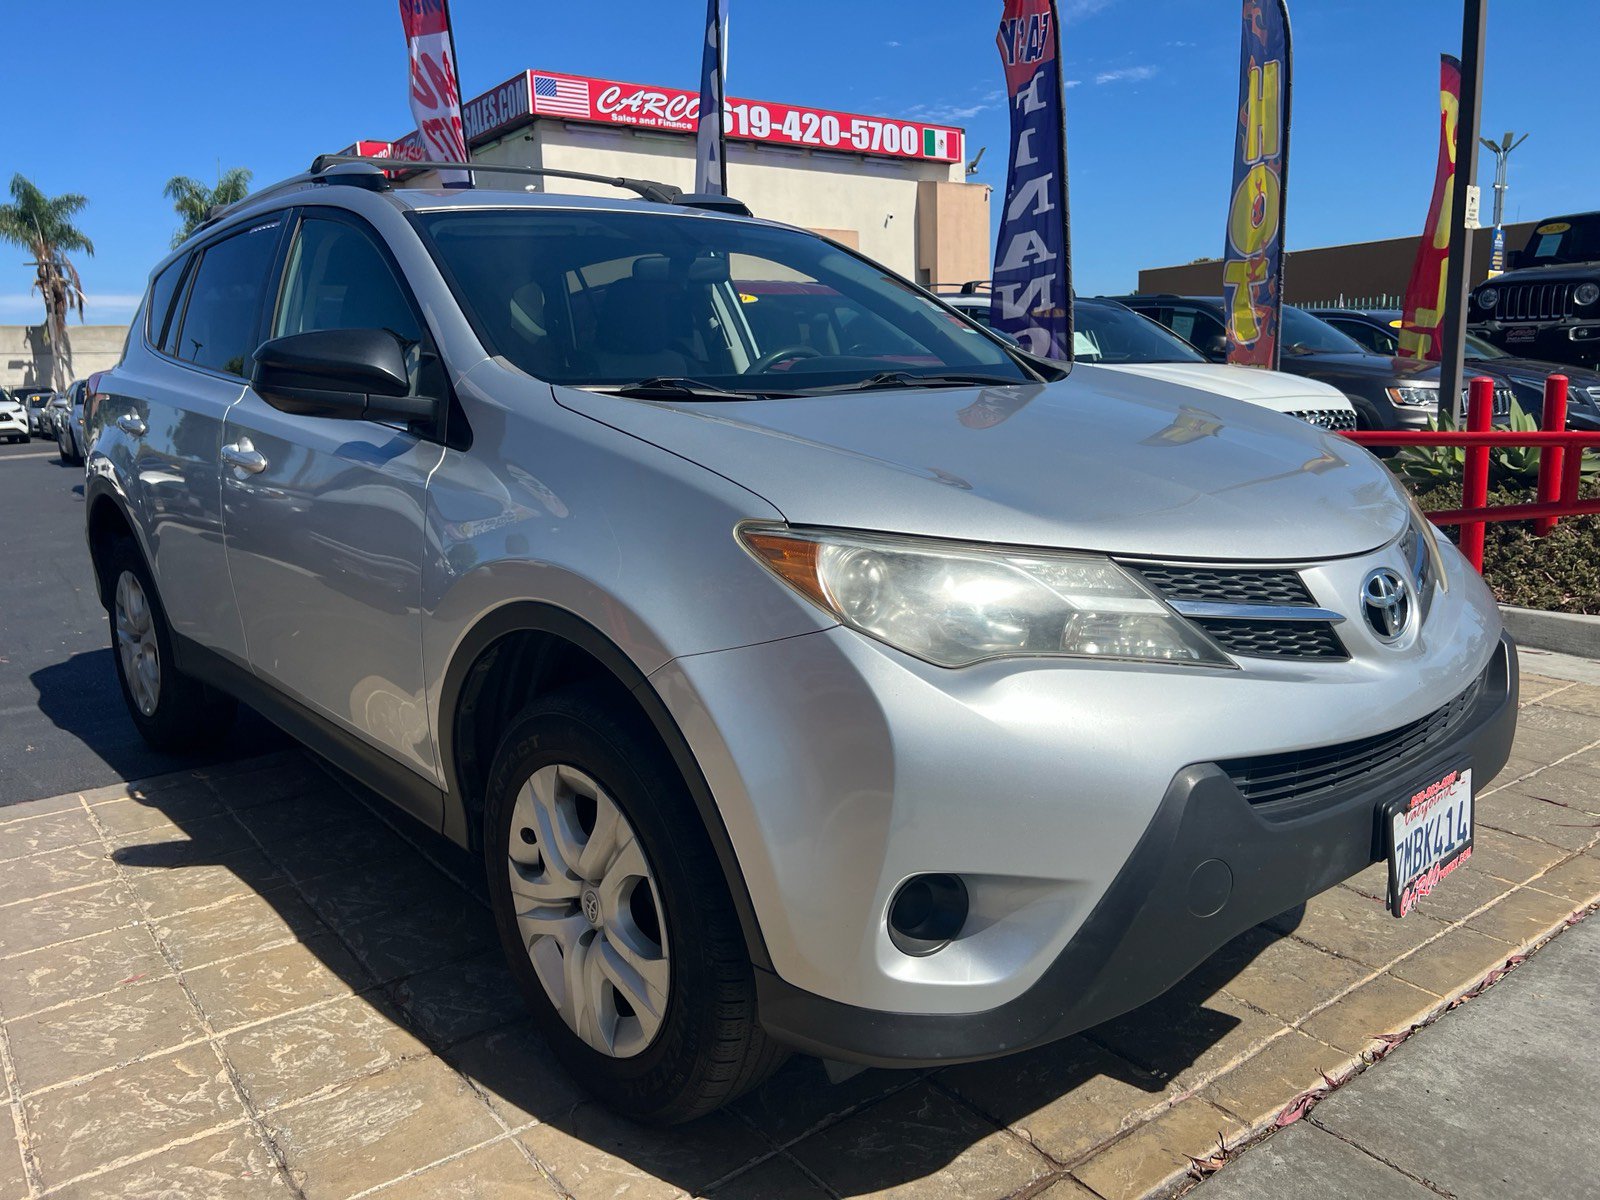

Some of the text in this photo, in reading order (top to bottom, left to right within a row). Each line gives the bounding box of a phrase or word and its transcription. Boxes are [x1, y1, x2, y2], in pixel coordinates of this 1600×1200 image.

[463, 77, 528, 140] SALES.COM
[597, 86, 700, 121] CARCO
[611, 113, 693, 130] Sales and Finance
[723, 99, 918, 155] 619-420-5700
[1223, 59, 1281, 344] HOT
[1396, 800, 1468, 888] 7MBK414
